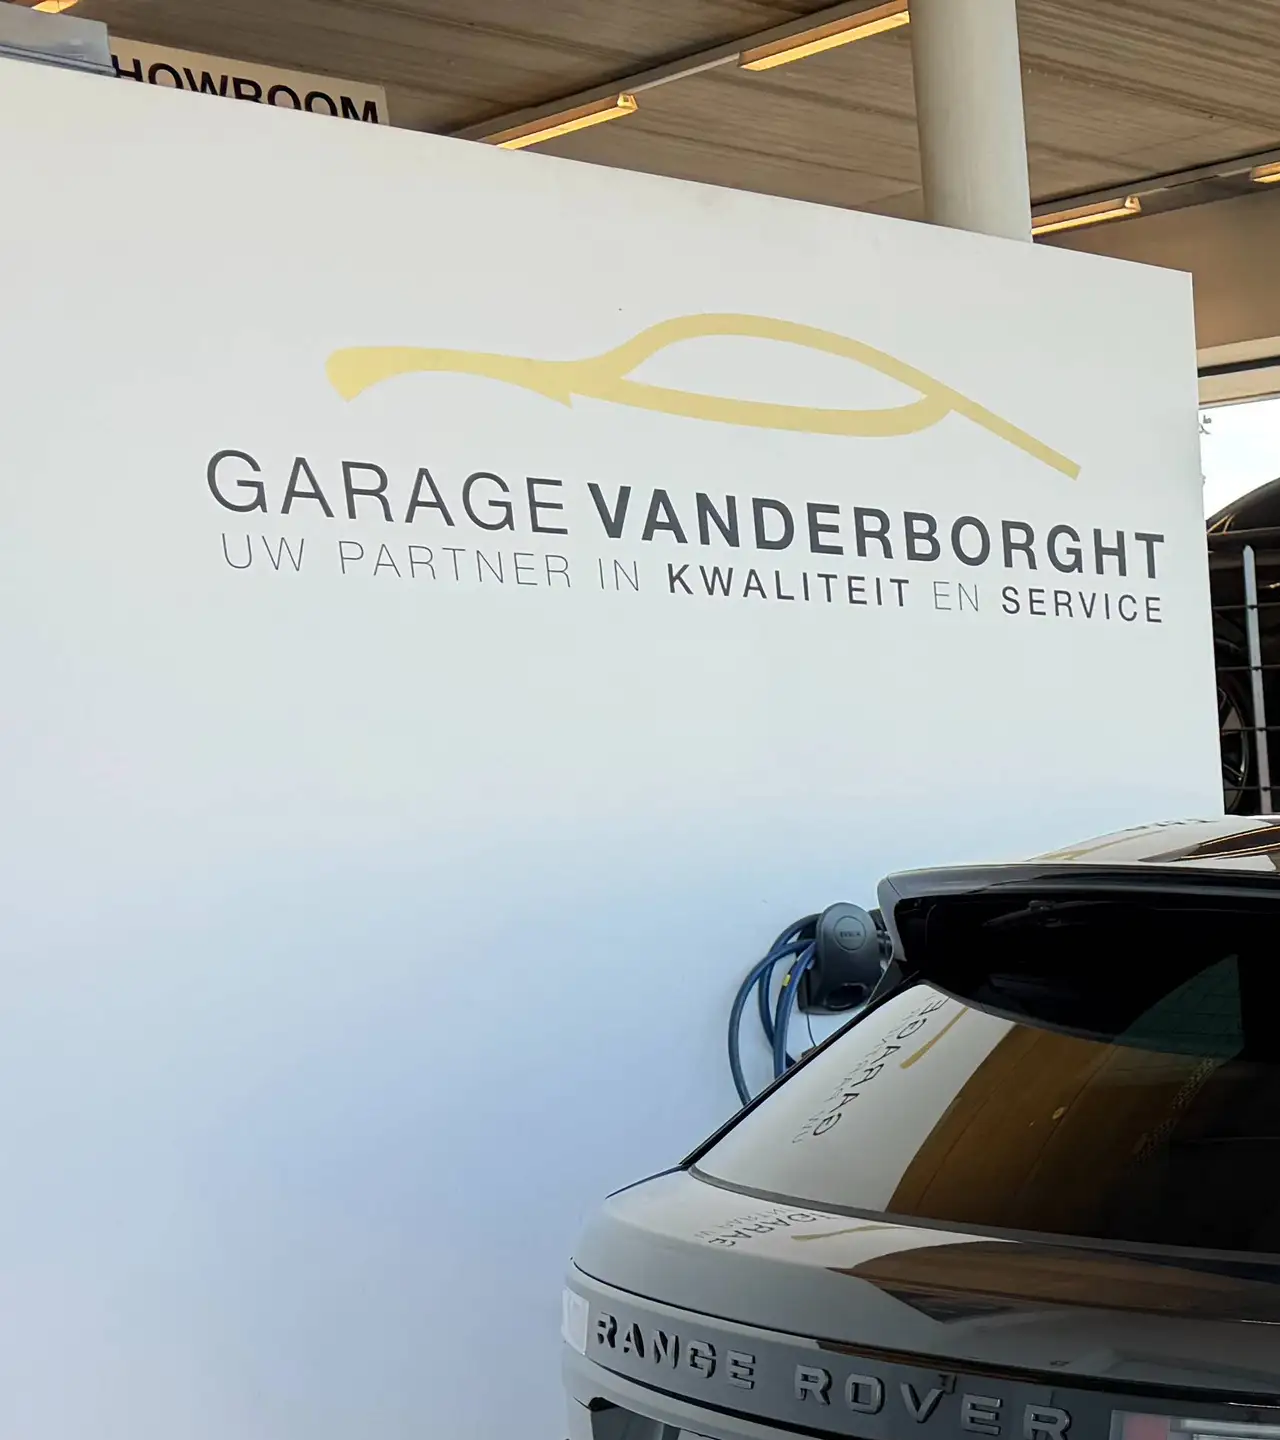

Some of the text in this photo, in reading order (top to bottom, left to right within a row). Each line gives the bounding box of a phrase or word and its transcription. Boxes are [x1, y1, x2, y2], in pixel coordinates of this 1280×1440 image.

[111, 54, 379, 124] HOWROOM
[207, 450, 1165, 579] GARAGE VANDERBORGHT
[222, 533, 1163, 623] UW PARTNER IN KWALITEIT EN SERVICE
[595, 1311, 756, 1389] RANGE
